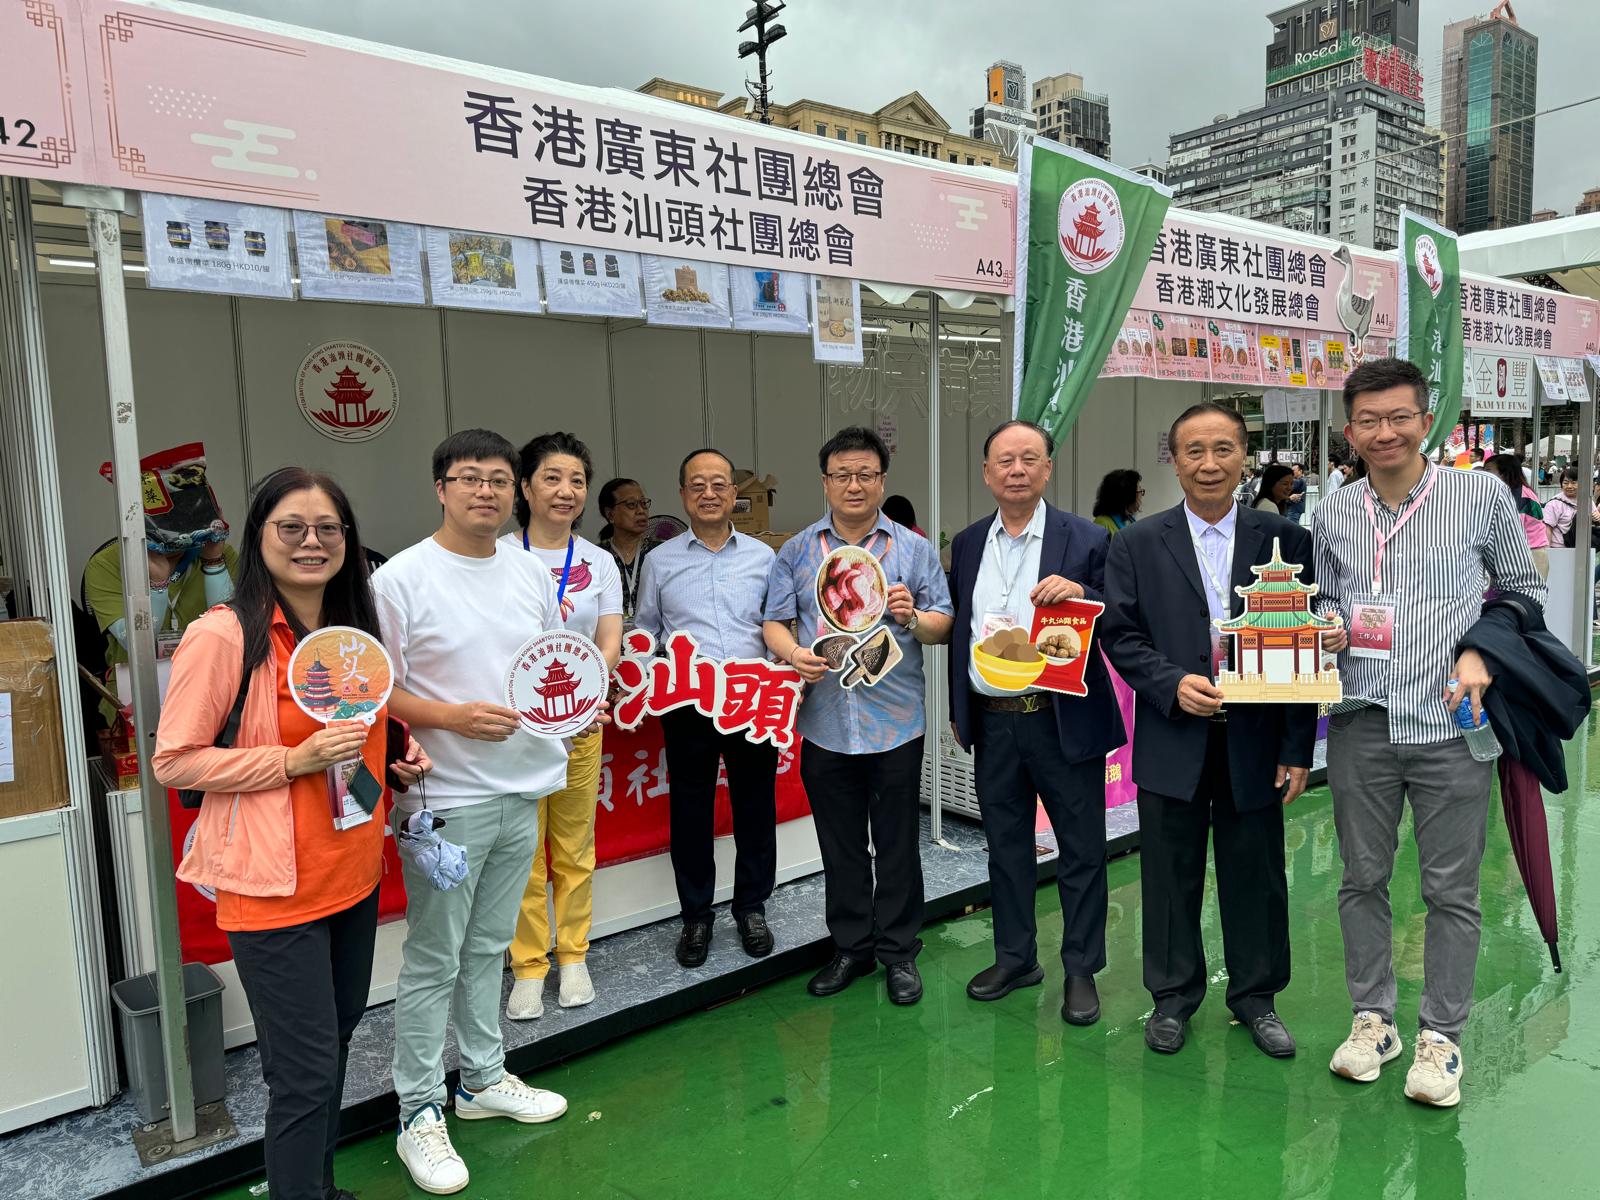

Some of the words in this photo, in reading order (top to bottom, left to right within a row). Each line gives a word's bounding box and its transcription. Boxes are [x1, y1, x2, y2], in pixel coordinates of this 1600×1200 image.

[463, 90, 885, 220] 香港廣東社團總會
[522, 176, 854, 267] 香港汕頭社團總會
[212, 259, 231, 270] 180g
[976, 258, 1003, 278] A43
[1155, 272, 1320, 322] 香港潮文化發展總會
[1375, 312, 1390, 327] A41
[1476, 400, 1494, 409] KAM
[1496, 400, 1505, 410] YU
[1508, 401, 1527, 410] FUNG
[533, 634, 555, 648] SHANTOU
[555, 633, 582, 644] COMMUNITY
[1357, 632, 1384, 642] 工作人員
[615, 632, 803, 744] 汕頭
